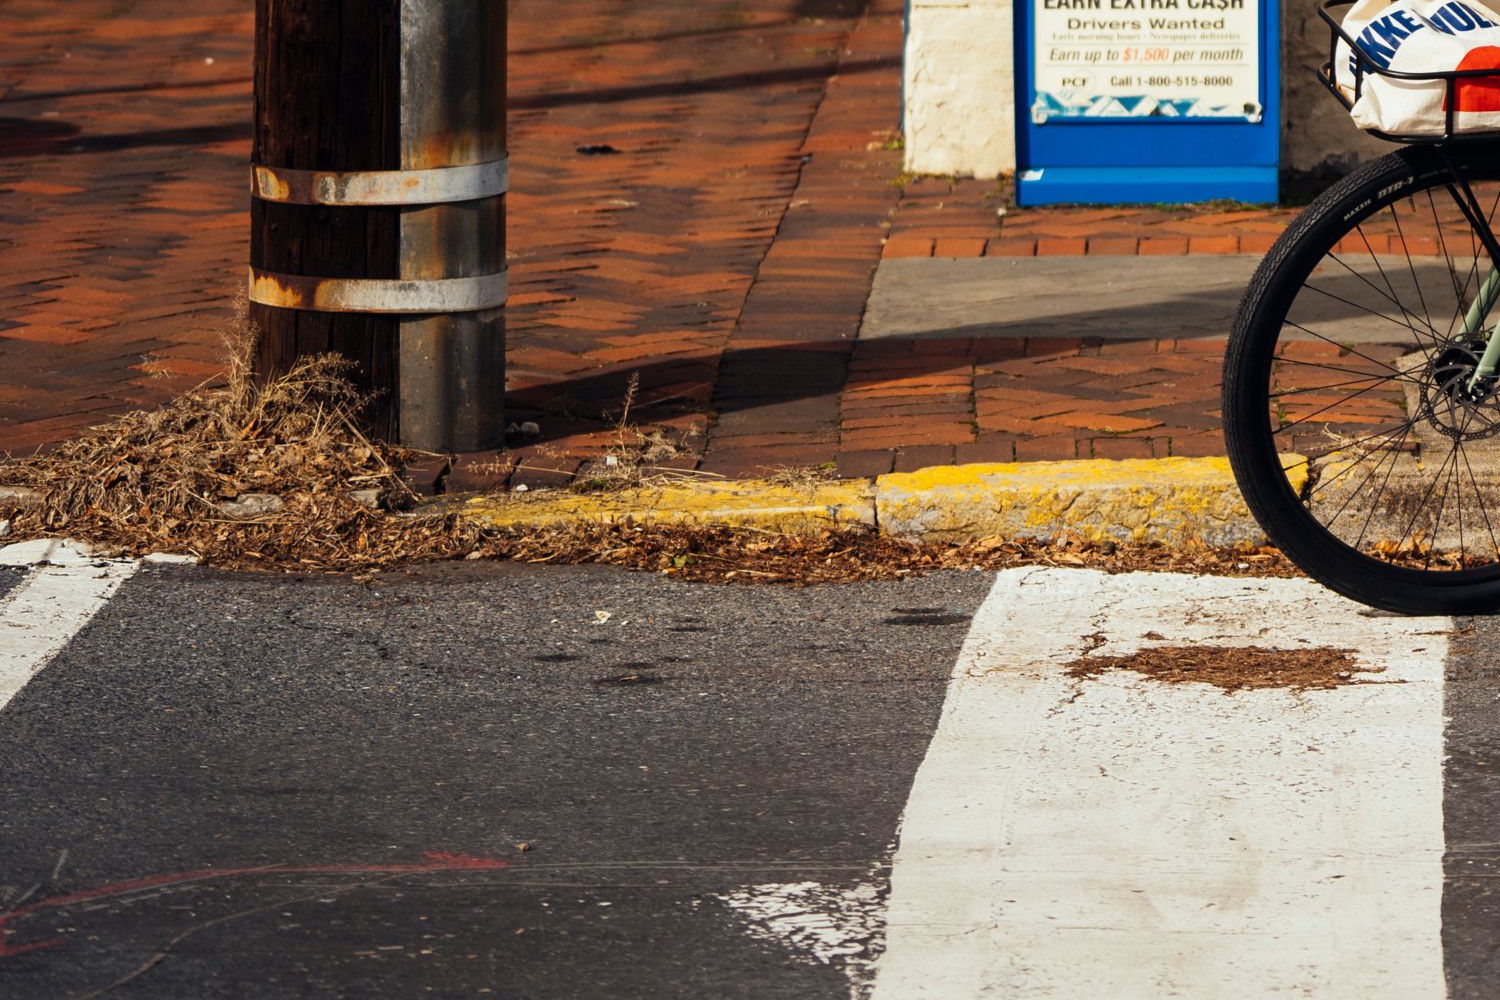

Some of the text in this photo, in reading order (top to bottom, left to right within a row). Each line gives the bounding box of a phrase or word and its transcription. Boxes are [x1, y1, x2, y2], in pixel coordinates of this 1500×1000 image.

[1067, 18, 1225, 30] Drivers Wanted
[1078, 33, 1113, 42] morning
[1150, 33, 1196, 42] Newspaper
[1050, 49, 1082, 61] Earn
[1085, 52, 1100, 64] up
[1106, 50, 1119, 61] to
[1173, 52, 1195, 64] per
[1200, 49, 1243, 61] month
[1062, 76, 1233, 88] PCF Call 1-800-515-8000
[1343, 198, 1372, 221] MAXXIS
